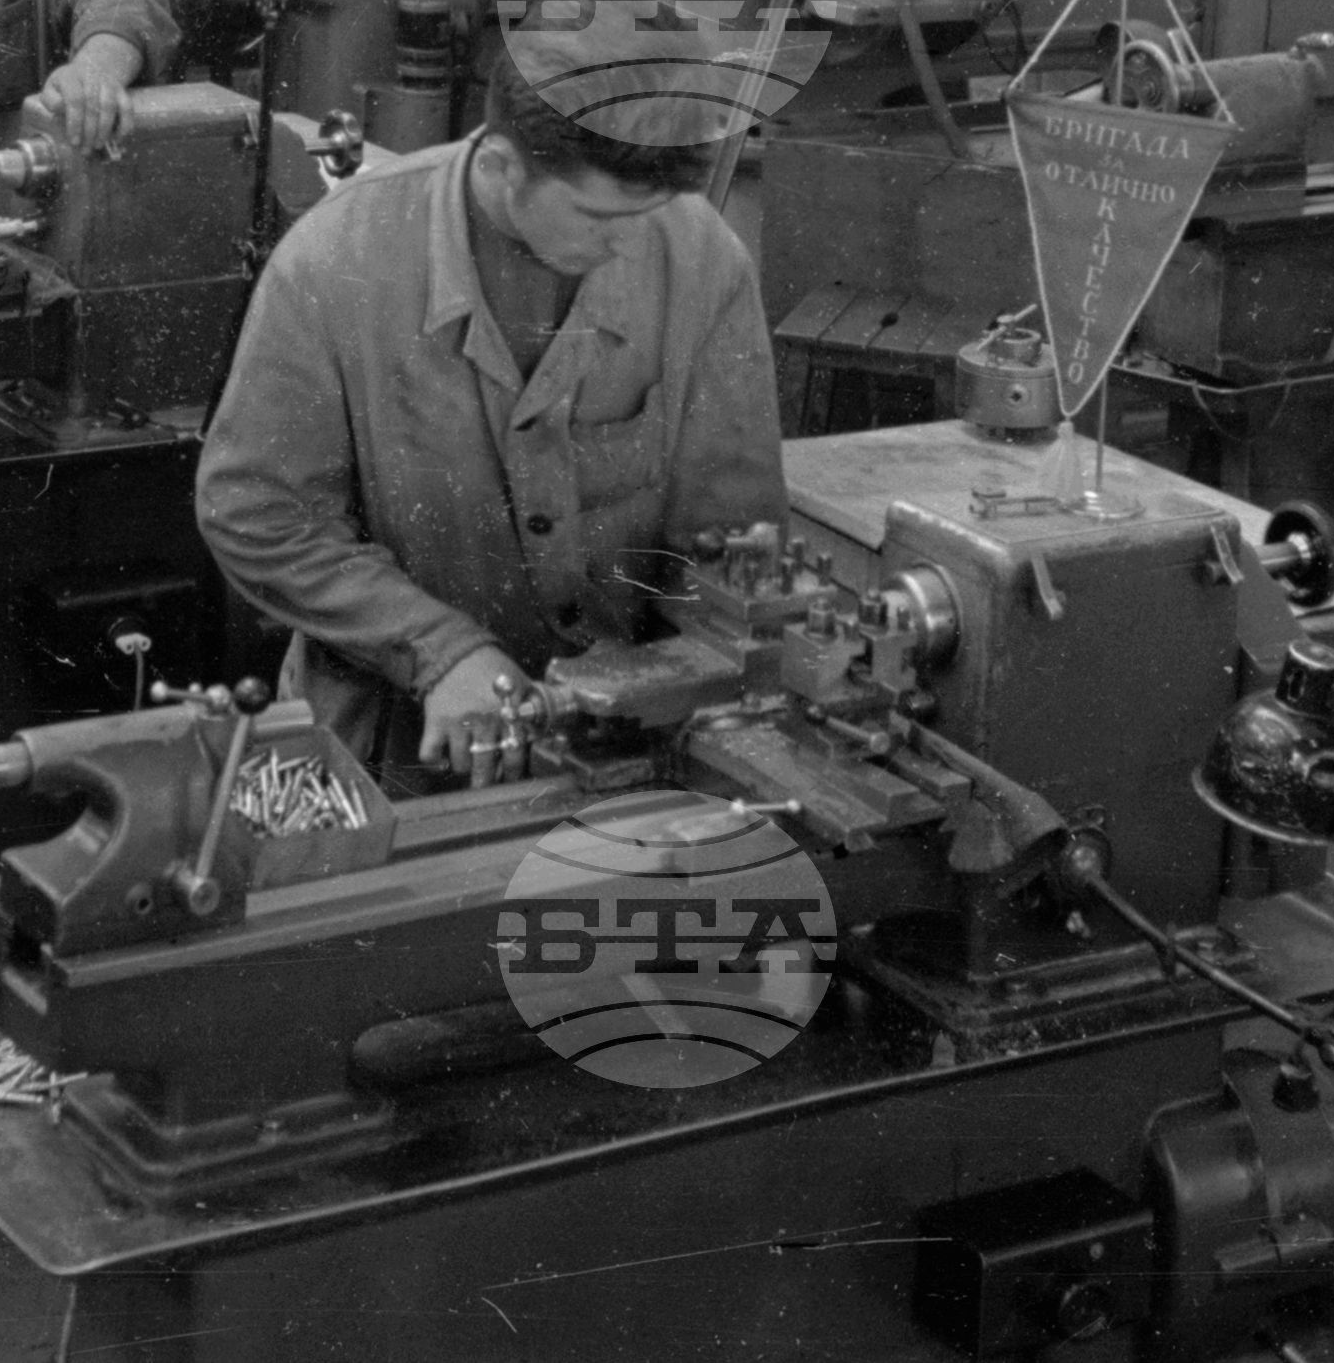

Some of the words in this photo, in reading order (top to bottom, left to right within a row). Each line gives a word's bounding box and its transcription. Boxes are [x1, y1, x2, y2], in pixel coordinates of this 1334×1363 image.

[1045, 116, 1189, 159] БРИГАДА
[1045, 162, 1175, 203] ОТЛИЧНО
[1099, 154, 1124, 172] ЗА
[1069, 197, 1116, 384] КАЧЕСТВО
